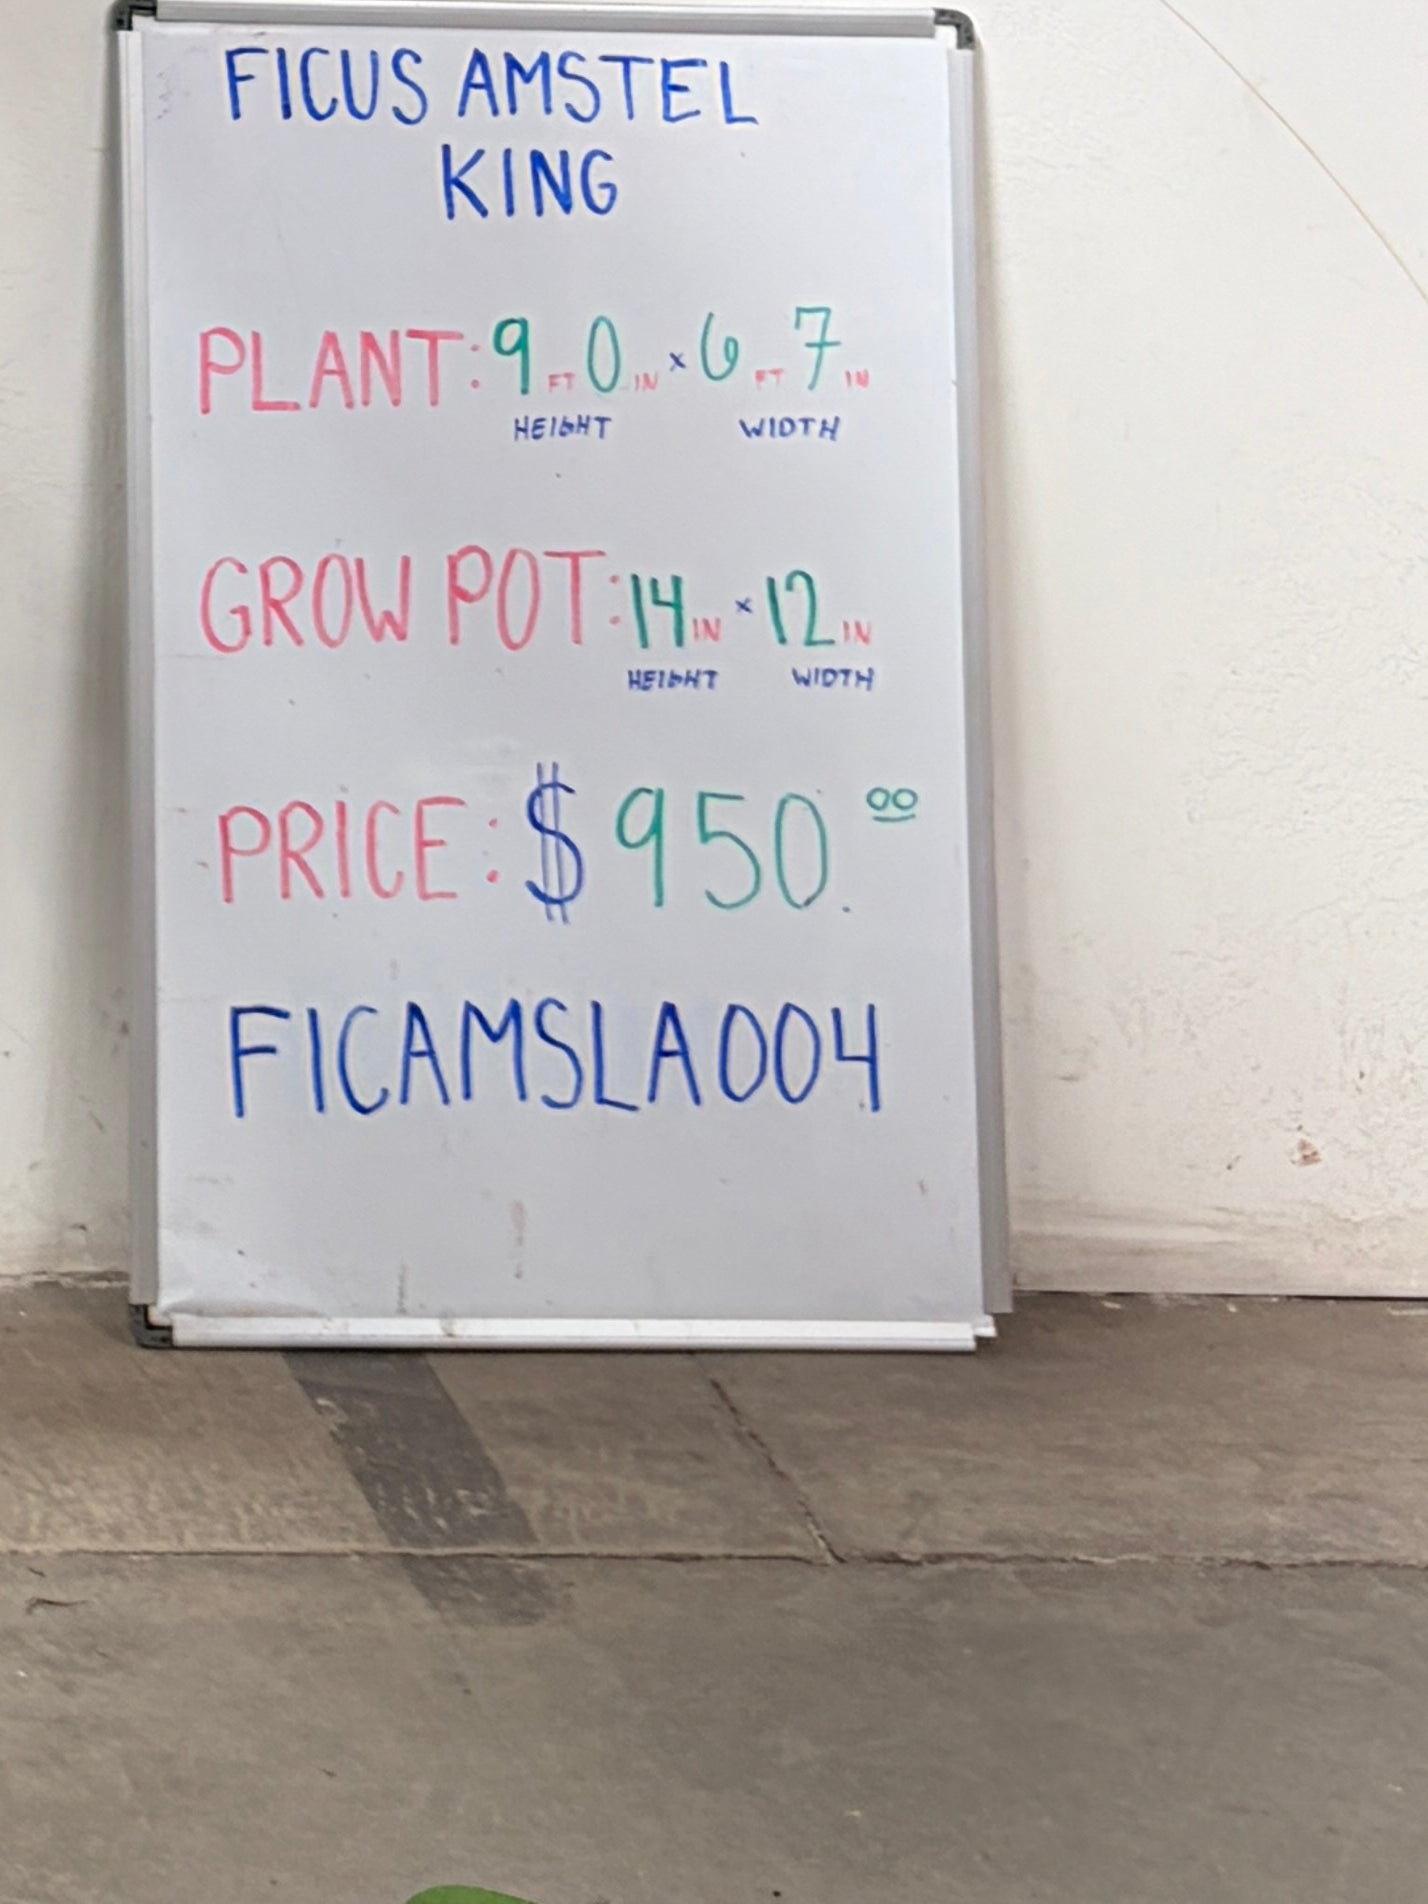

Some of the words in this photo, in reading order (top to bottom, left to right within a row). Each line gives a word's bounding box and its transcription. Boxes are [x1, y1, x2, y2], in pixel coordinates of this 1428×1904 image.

[225, 46, 428, 127] FICUS
[457, 48, 759, 126] AMSTEL
[441, 144, 618, 220] KING
[200, 326, 480, 415] PLANT:
[514, 415, 613, 442] HEIGHT
[739, 415, 841, 442] WIDTH
[201, 554, 412, 653] GROW
[447, 545, 620, 651] POT:
[628, 668, 719, 692] HEIGHT
[792, 666, 875, 692] WIDTH
[218, 796, 498, 904] PRICE:
[230, 996, 882, 1119] FICAMSLA004
